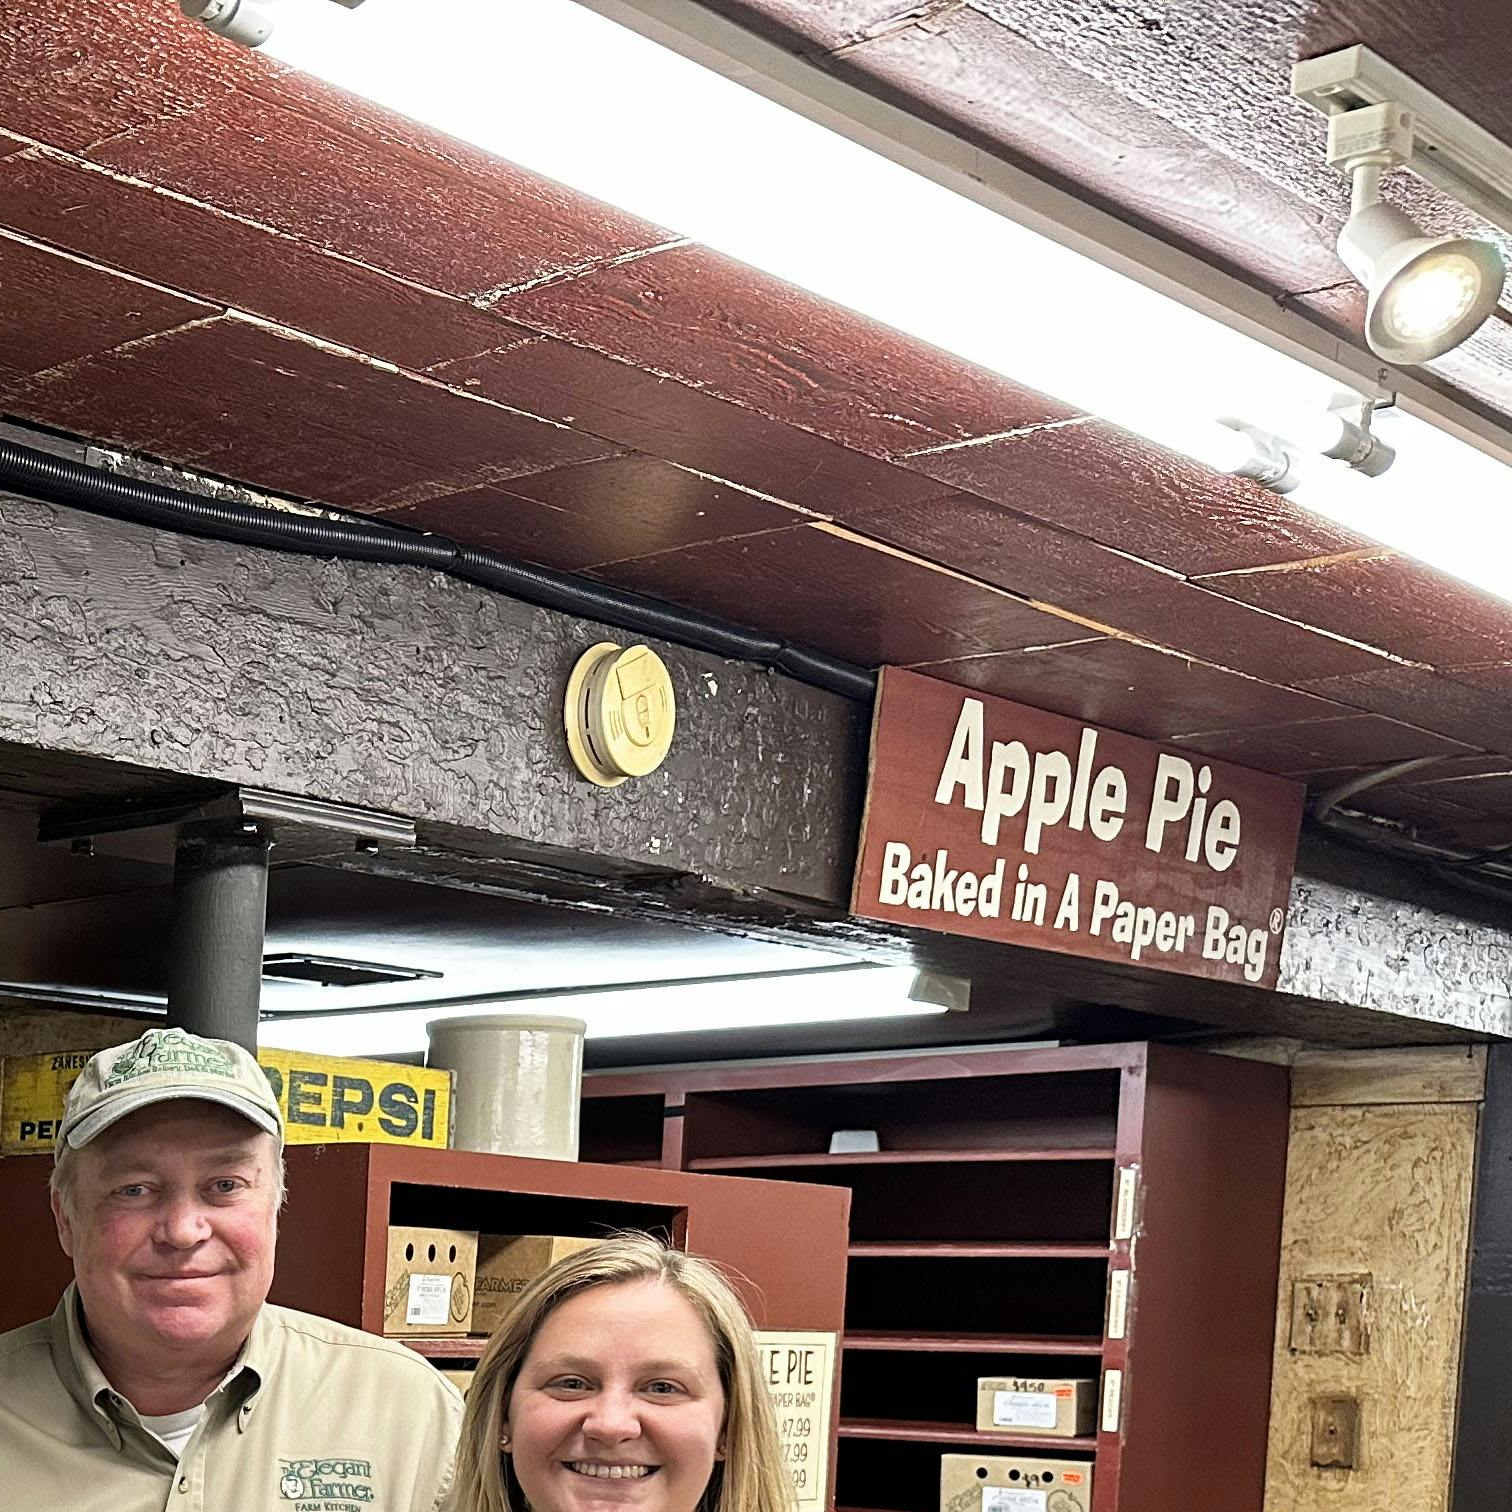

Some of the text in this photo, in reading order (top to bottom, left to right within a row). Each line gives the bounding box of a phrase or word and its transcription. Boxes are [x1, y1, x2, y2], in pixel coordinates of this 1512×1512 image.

[935, 697, 1241, 871] Apple Pie
[879, 841, 1005, 918] Baked
[1012, 863, 1047, 926] in
[1054, 873, 1080, 931] A
[1090, 880, 1194, 960] Paper
[787, 1350, 815, 1385] PIE
[782, 1417, 812, 1438] $7.99
[296, 1460, 371, 1479] Elegant
[295, 1502, 361, 1512] FARM KITCHEN
